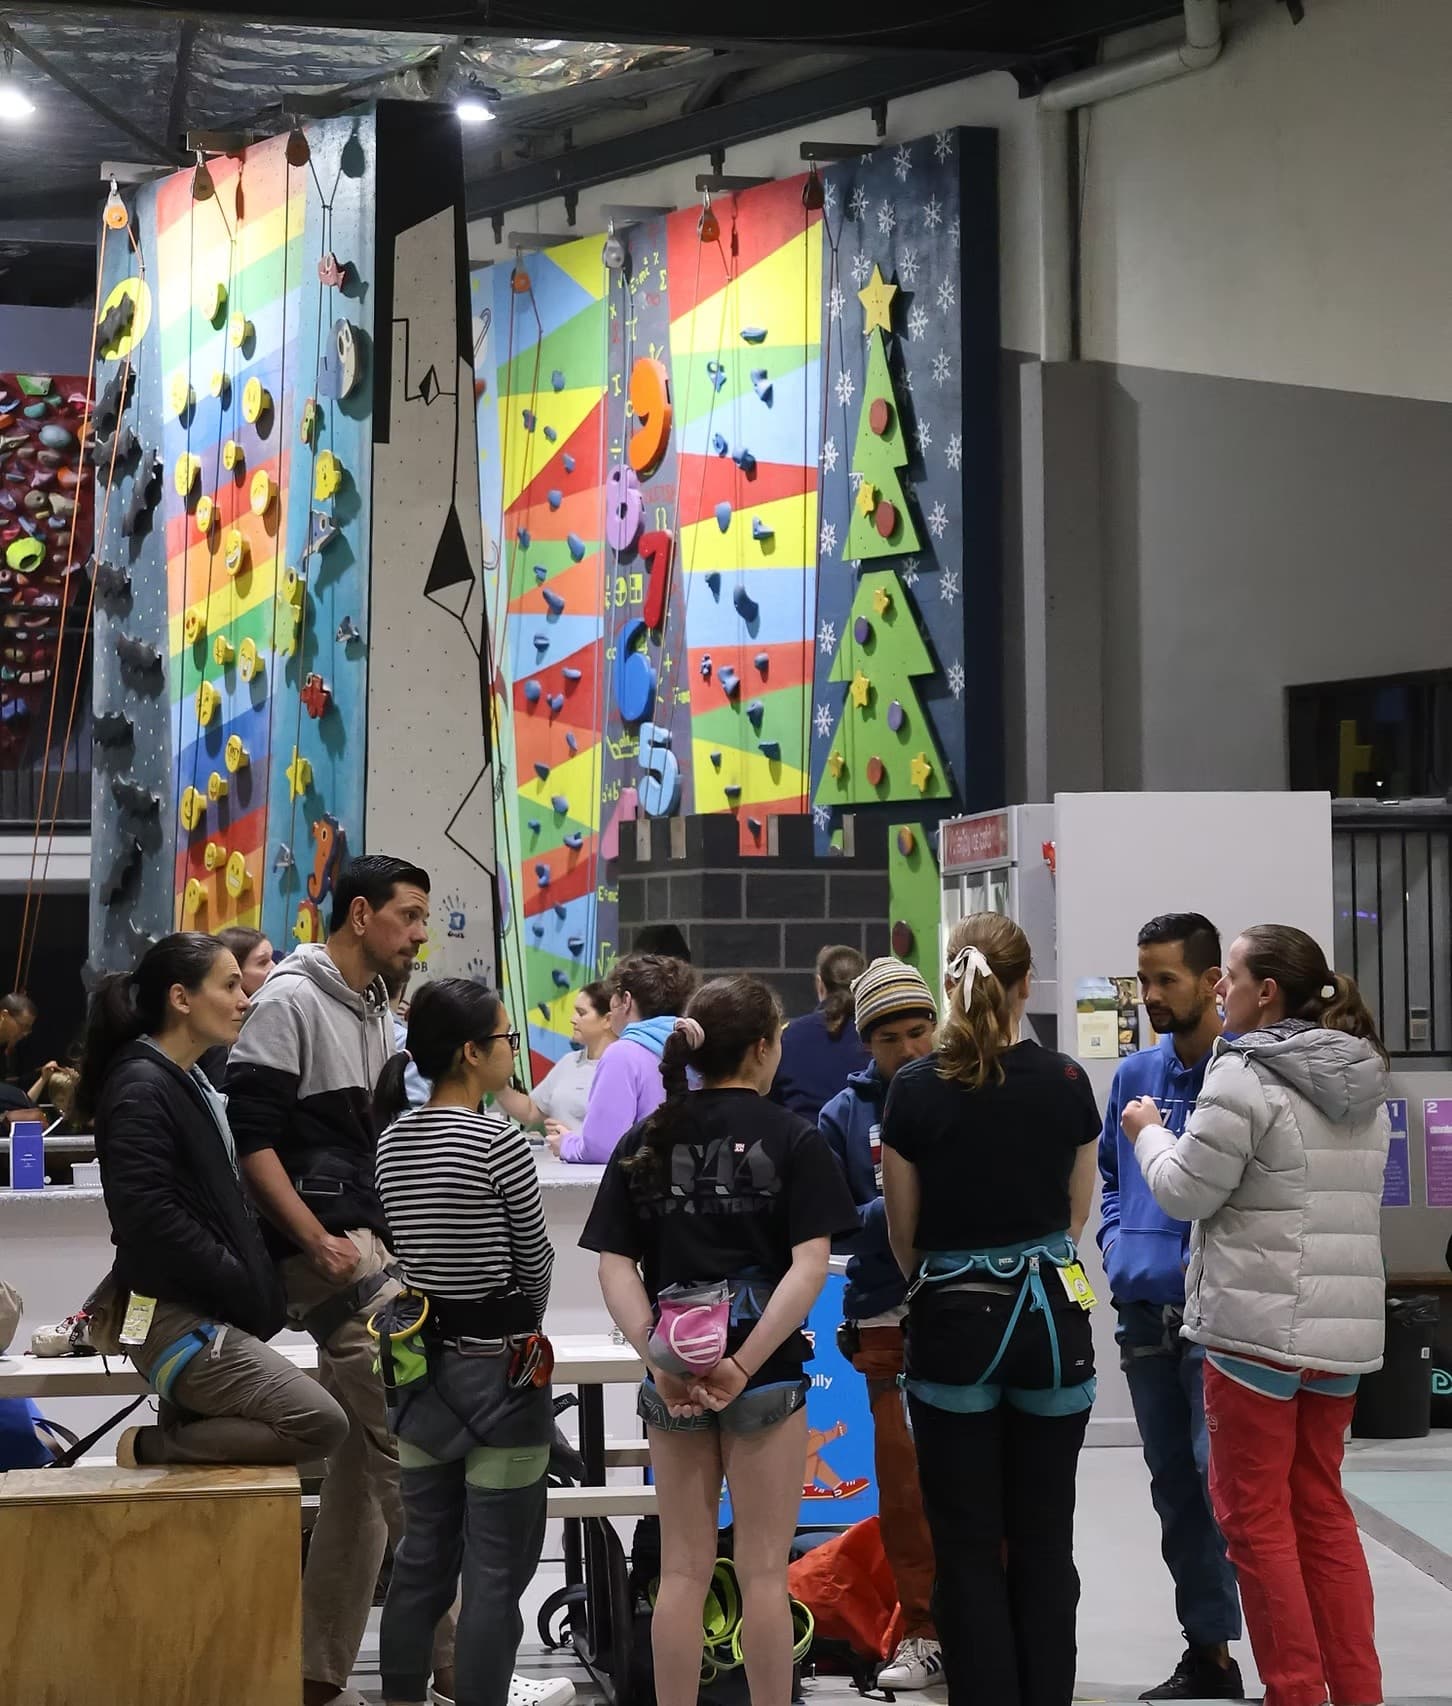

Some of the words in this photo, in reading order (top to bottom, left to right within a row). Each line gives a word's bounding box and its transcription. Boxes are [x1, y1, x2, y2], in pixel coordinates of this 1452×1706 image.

[629, 358, 672, 471] 9
[606, 464, 645, 551] 8
[638, 530, 676, 629] 7
[614, 618, 657, 722] 6
[638, 721, 681, 817] 5
[1391, 1102, 1399, 1118] 1
[1426, 1101, 1439, 1114] 2
